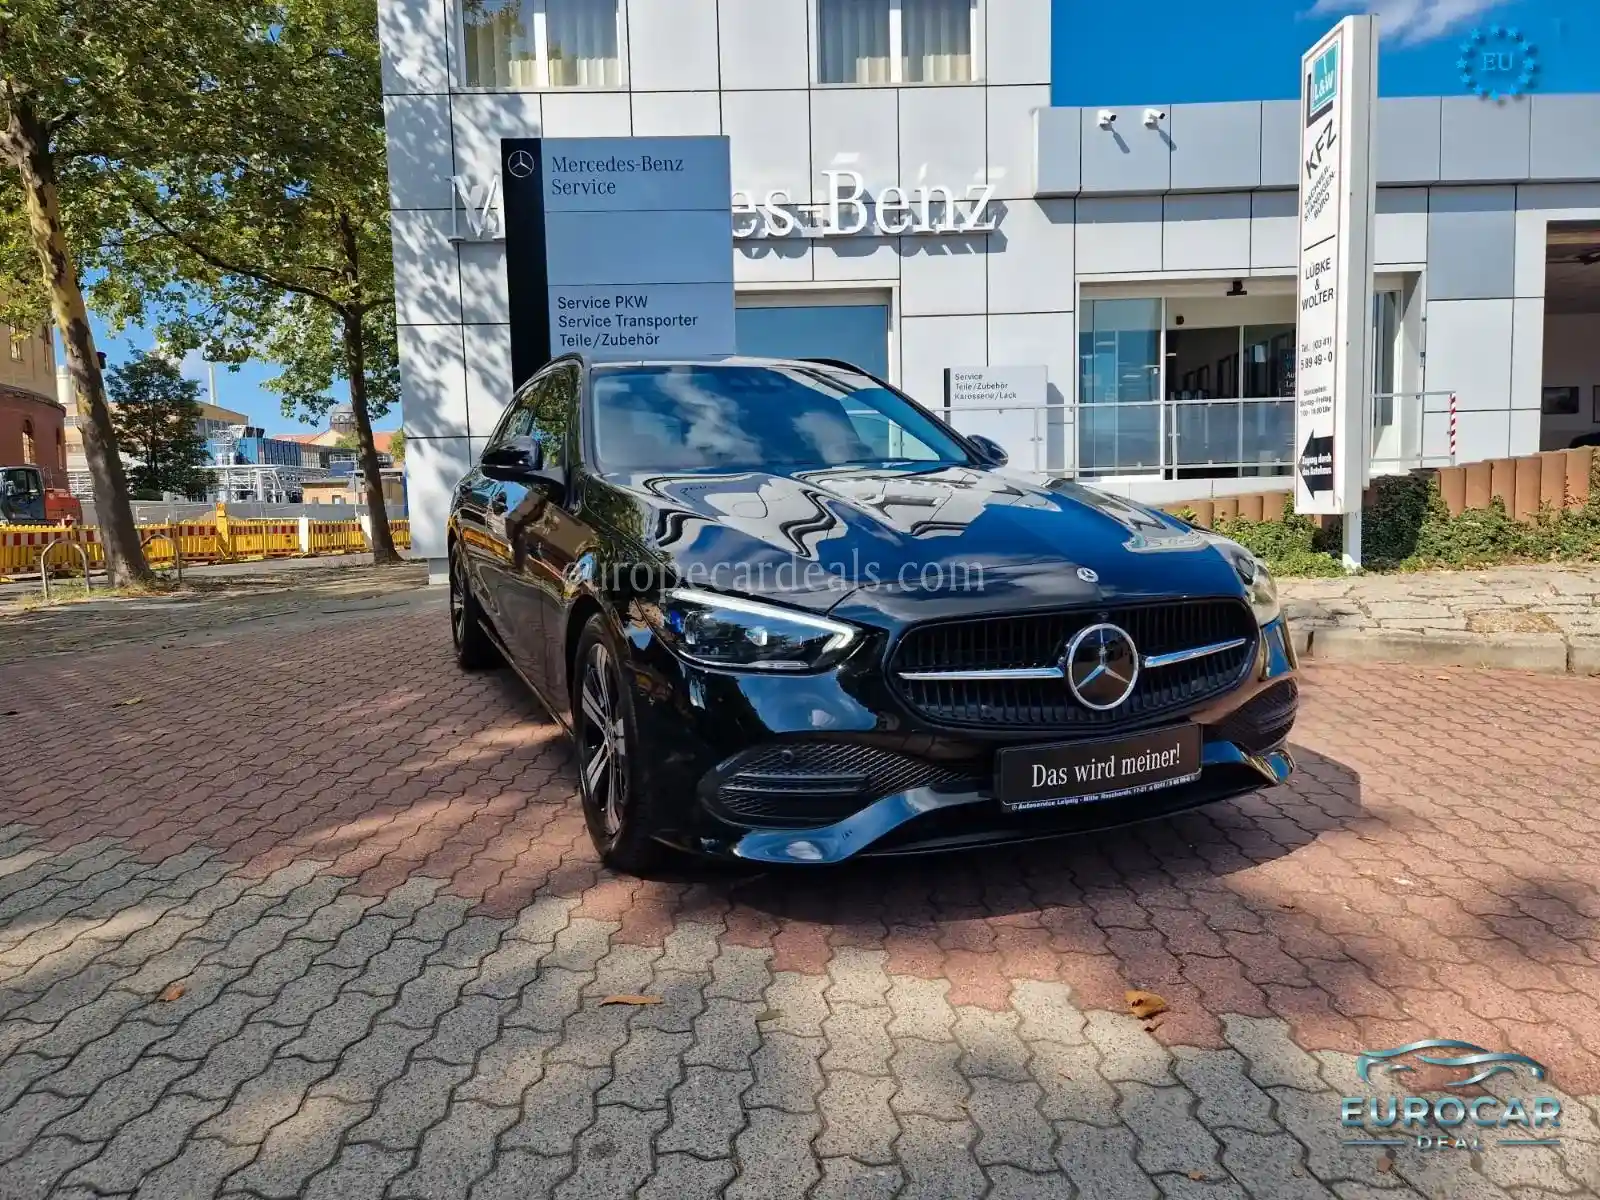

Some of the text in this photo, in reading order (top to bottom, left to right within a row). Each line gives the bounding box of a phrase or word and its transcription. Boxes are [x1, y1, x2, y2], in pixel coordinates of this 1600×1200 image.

[1306, 118, 1337, 179] KFZ
[552, 155, 685, 173] Mercedes-Benz
[552, 178, 617, 195] Service
[1306, 256, 1331, 280] LÜBKE
[1314, 278, 1321, 291] &
[557, 295, 649, 310] Service PKW
[1301, 287, 1334, 311] WOLTER
[558, 313, 699, 330] Service Transporter
[560, 332, 660, 348] Teile/Zubehör
[955, 373, 983, 381] Service
[1031, 742, 1181, 788] Das wird meiner!
